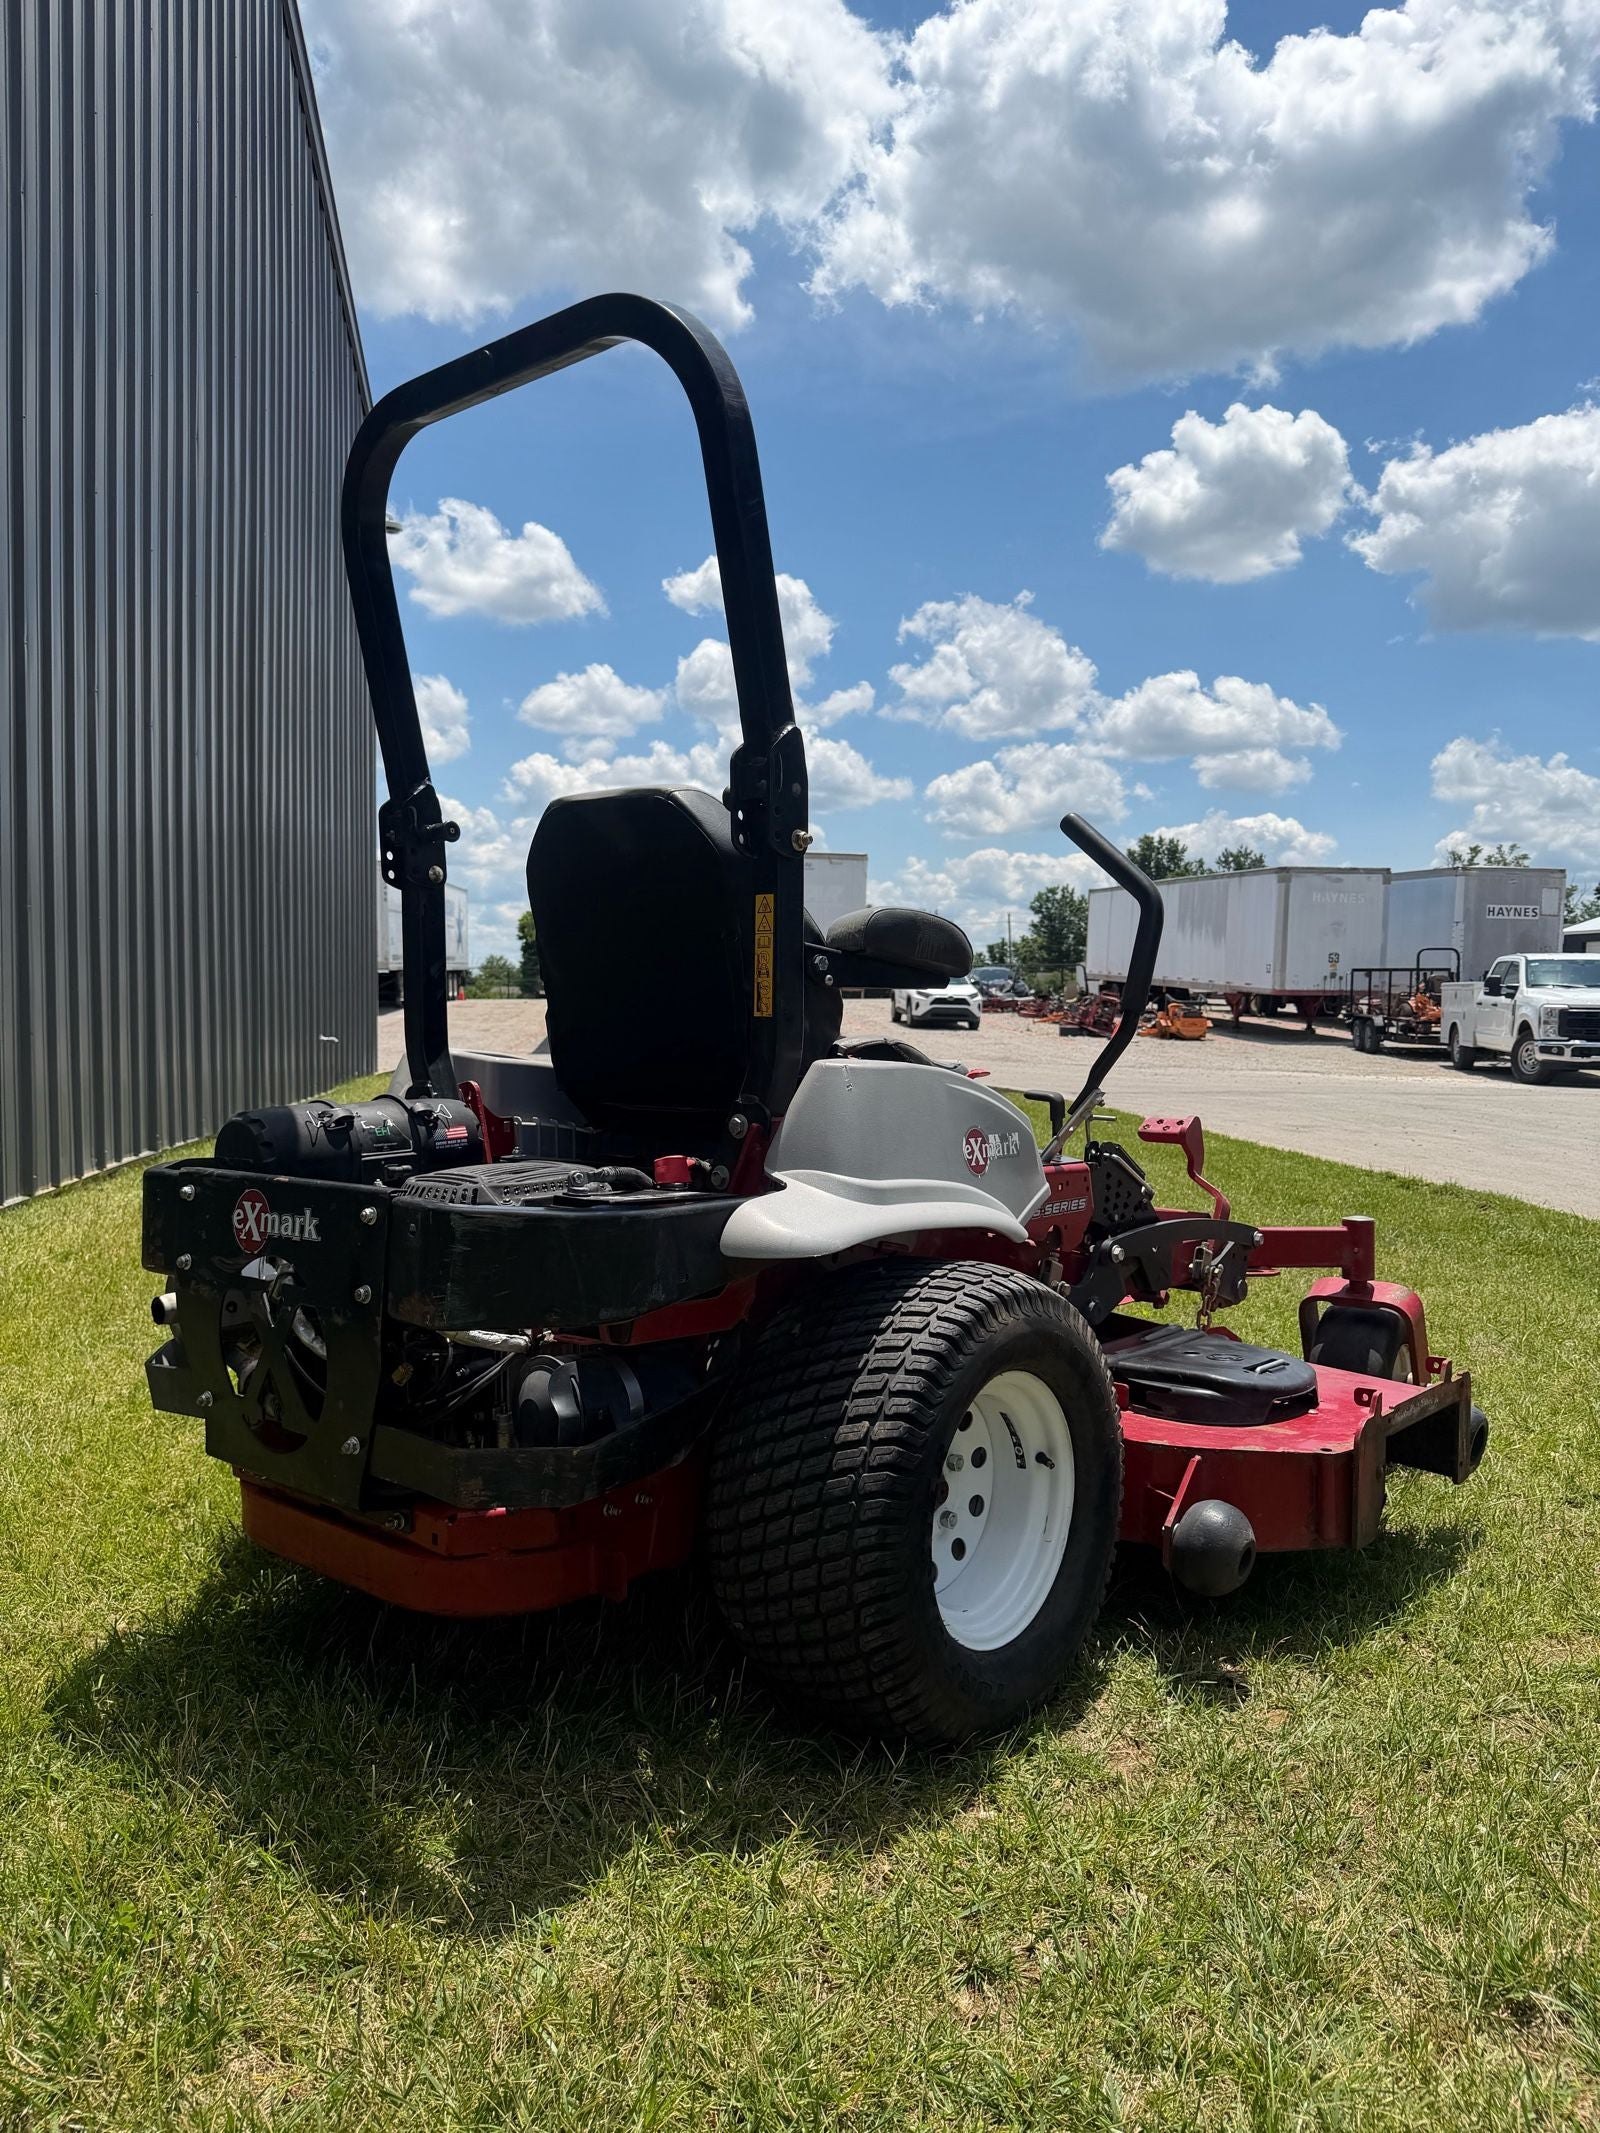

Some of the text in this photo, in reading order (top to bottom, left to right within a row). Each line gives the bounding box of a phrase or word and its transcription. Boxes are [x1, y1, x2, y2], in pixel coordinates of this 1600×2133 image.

[1312, 891, 1366, 905] HAYNES
[1487, 906, 1538, 918] HAYNES
[233, 1200, 321, 1241] eXmark
